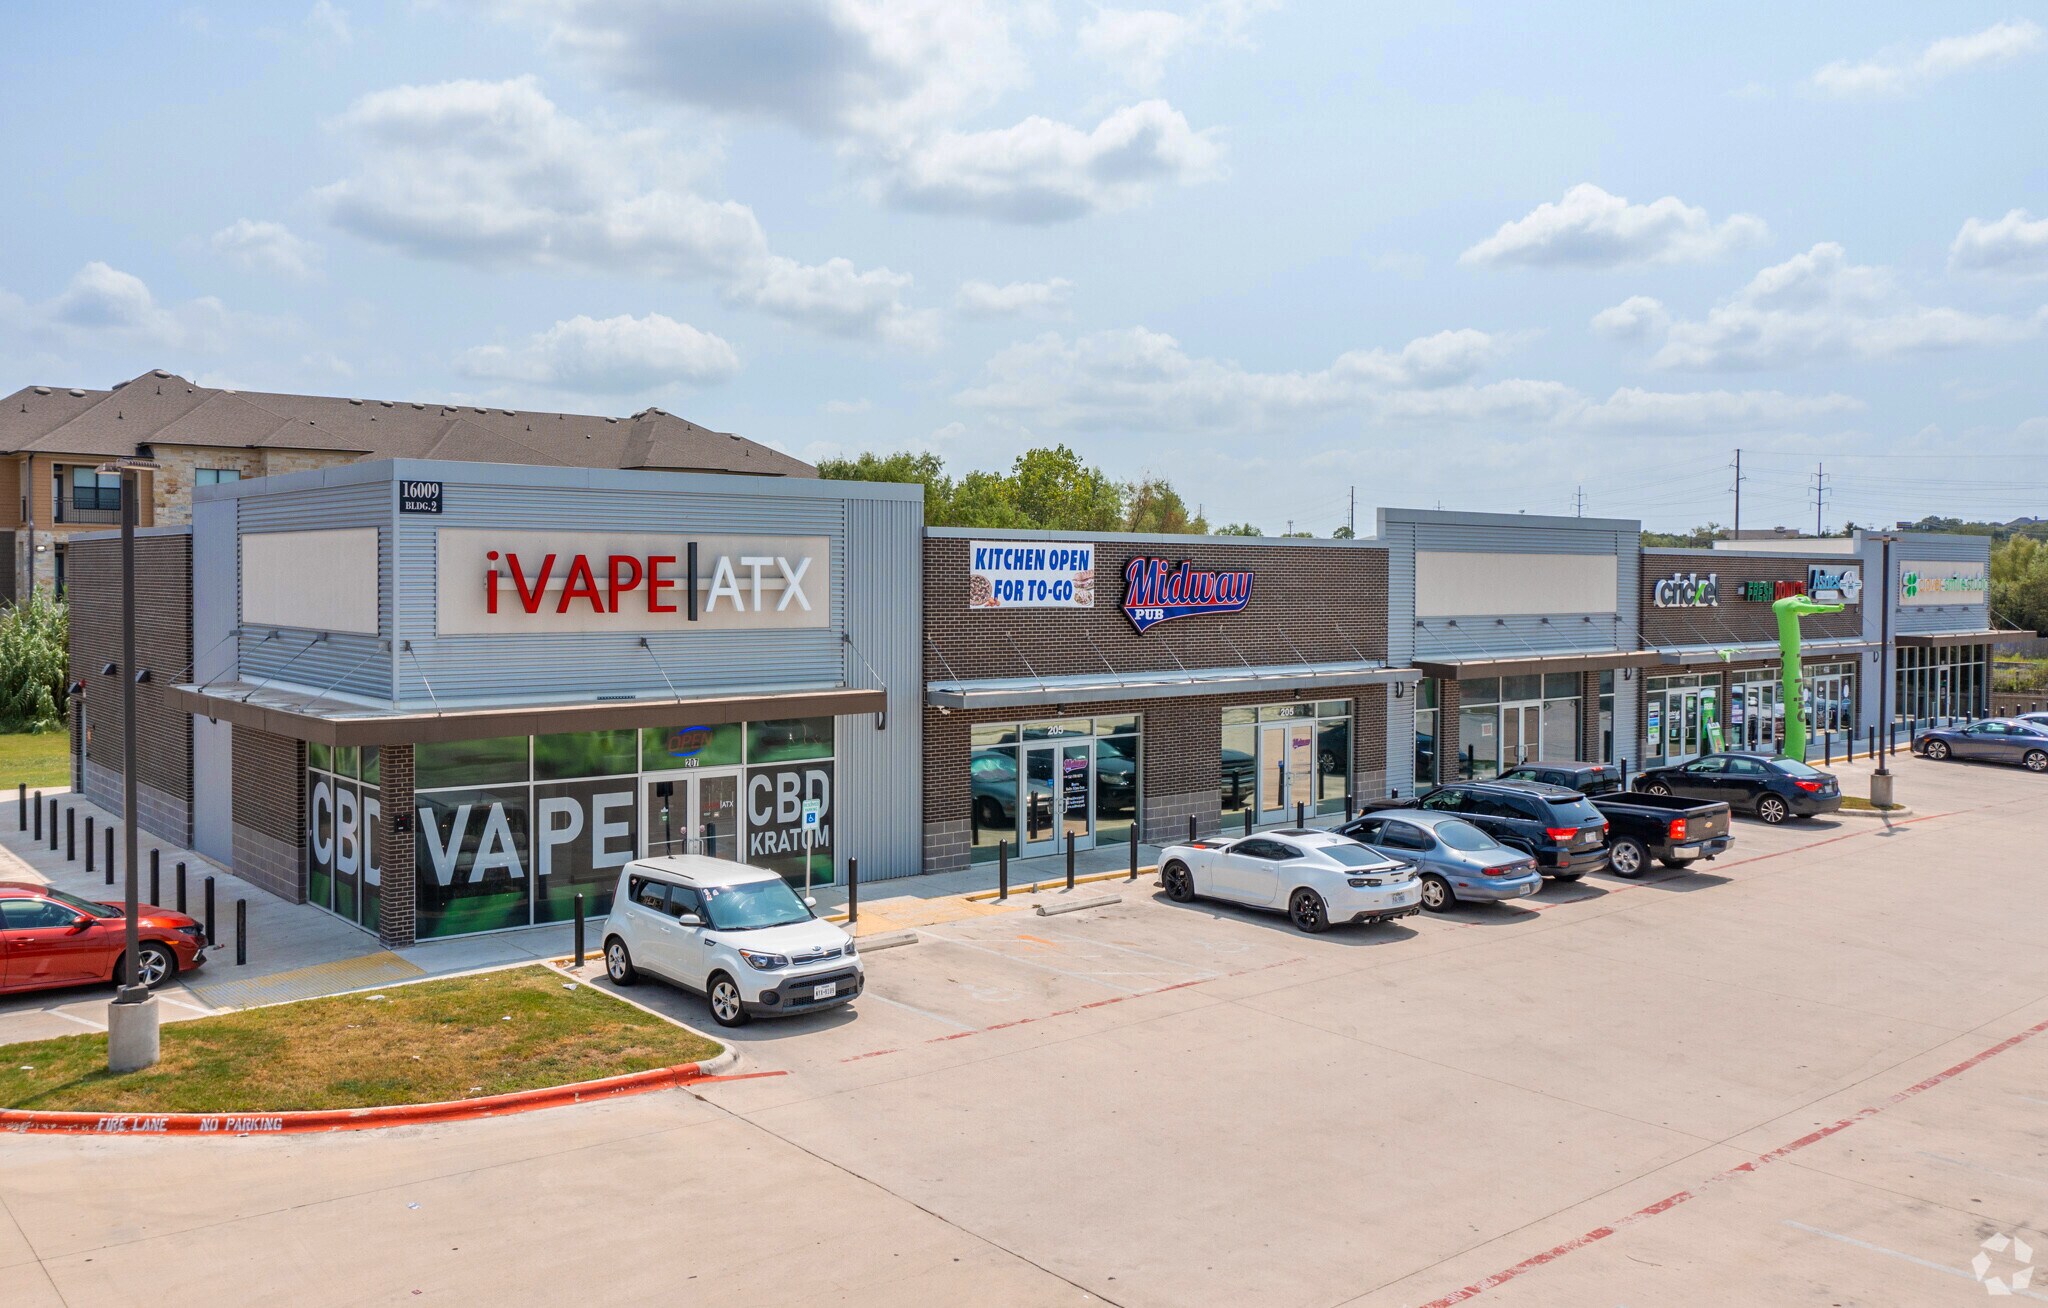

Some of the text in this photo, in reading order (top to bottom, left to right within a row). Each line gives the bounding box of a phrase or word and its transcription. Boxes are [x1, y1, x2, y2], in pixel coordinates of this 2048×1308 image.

[402, 481, 439, 499] 16009
[974, 547, 1090, 571] KITCHEN OPEN
[993, 579, 1073, 601] FOR TO-GO
[1124, 556, 1254, 611] Midway
[1746, 581, 1775, 602] FRESH
[1134, 608, 1164, 620] PUB
[1281, 708, 1294, 717] 205
[1047, 726, 1064, 735] 205
[668, 731, 714, 752] OPEN
[685, 758, 699, 767] 207
[747, 769, 830, 827] CBD
[418, 791, 634, 887] VAPE
[97, 1117, 169, 1132] FIRE LANE
[200, 1117, 282, 1132] NO PARKING
